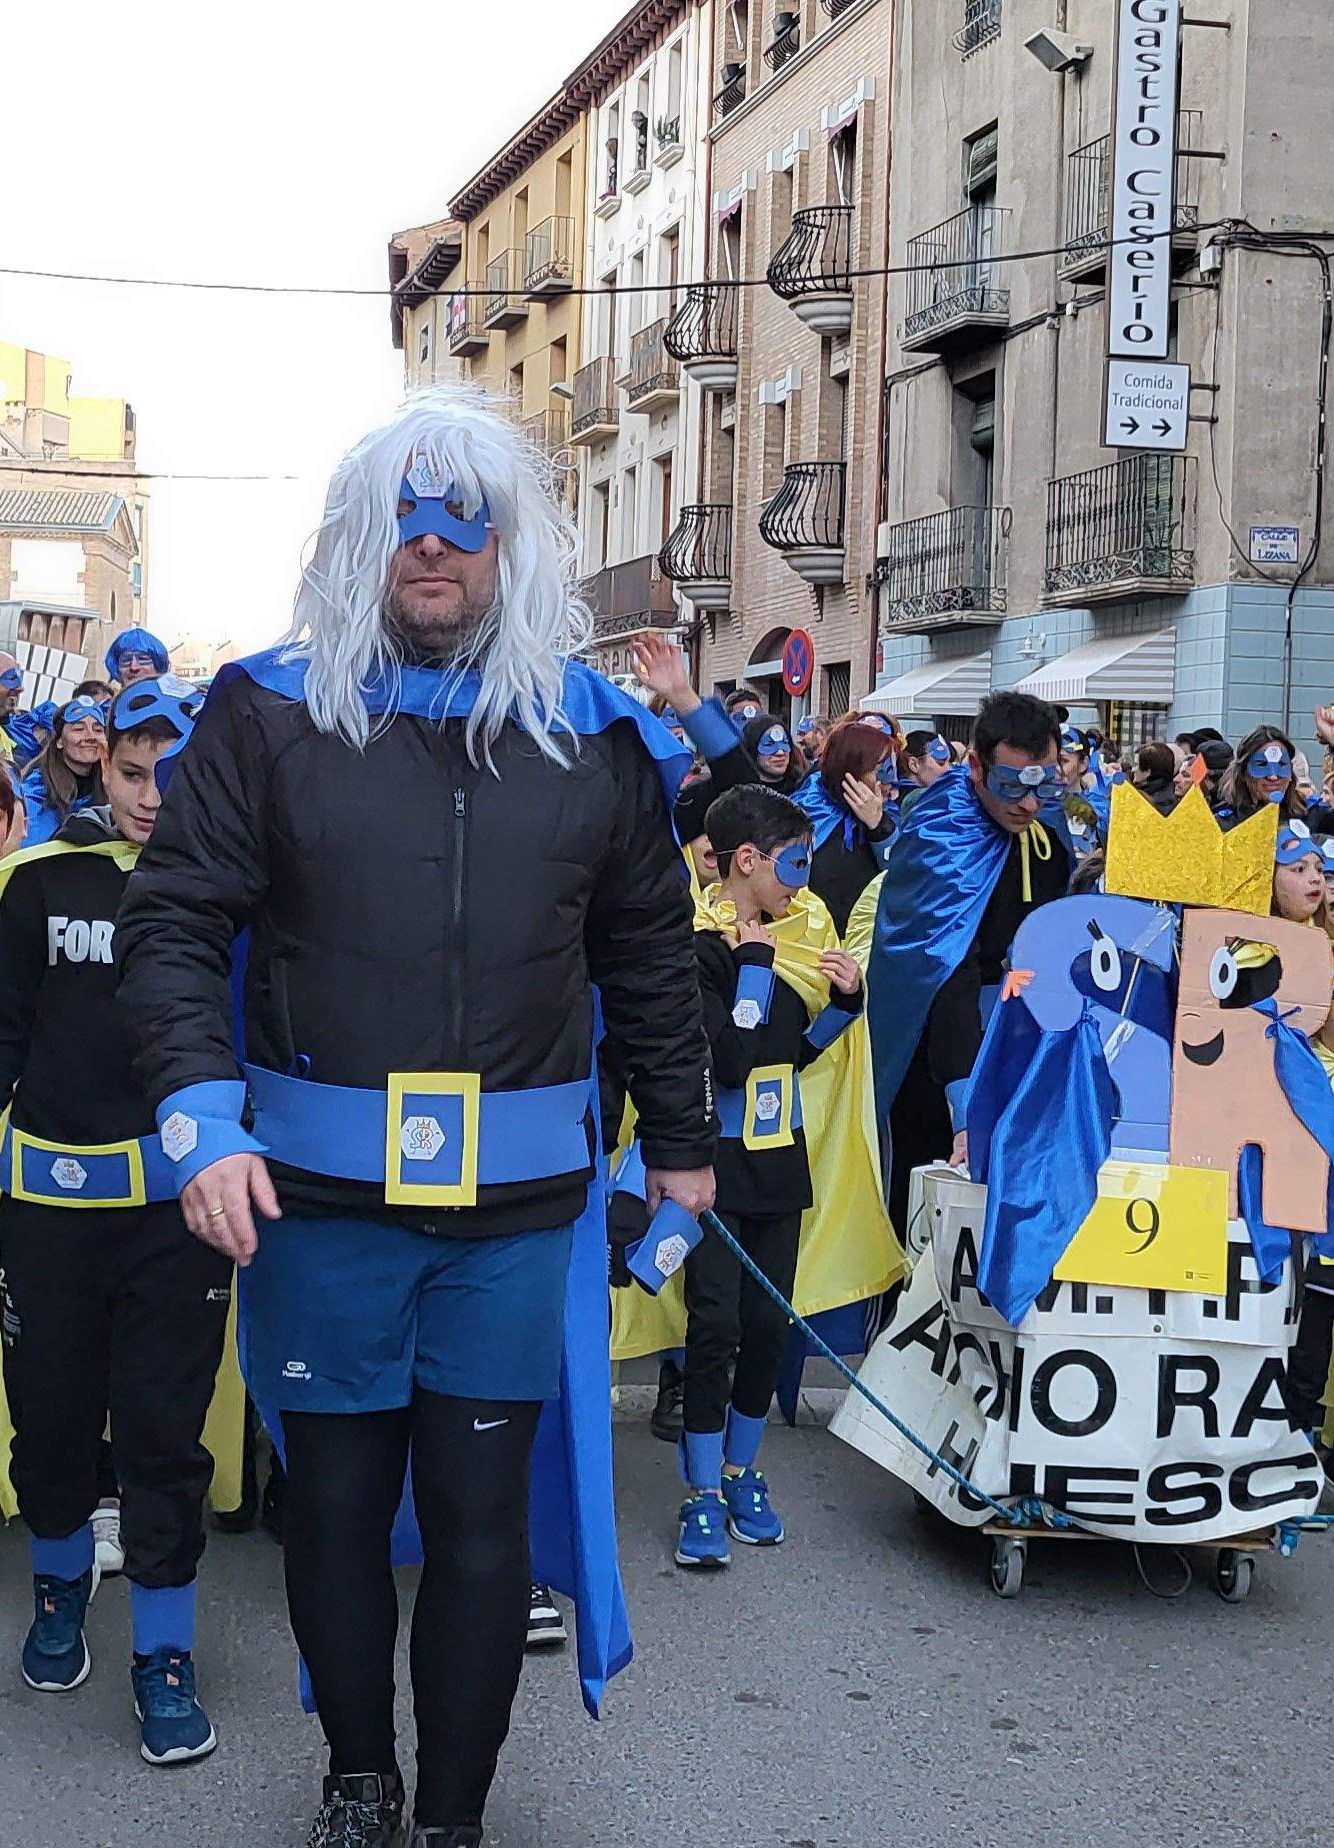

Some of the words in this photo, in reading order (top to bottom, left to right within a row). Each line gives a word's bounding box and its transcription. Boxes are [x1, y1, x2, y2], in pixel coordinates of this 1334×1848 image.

[1129, 0, 1169, 146] Gastro
[1122, 169, 1163, 344] Caserío
[1112, 392, 1184, 411] Tradicional
[1124, 373, 1173, 390] Comida
[47, 915, 116, 967] FOR
[1124, 1197, 1160, 1255] 9
